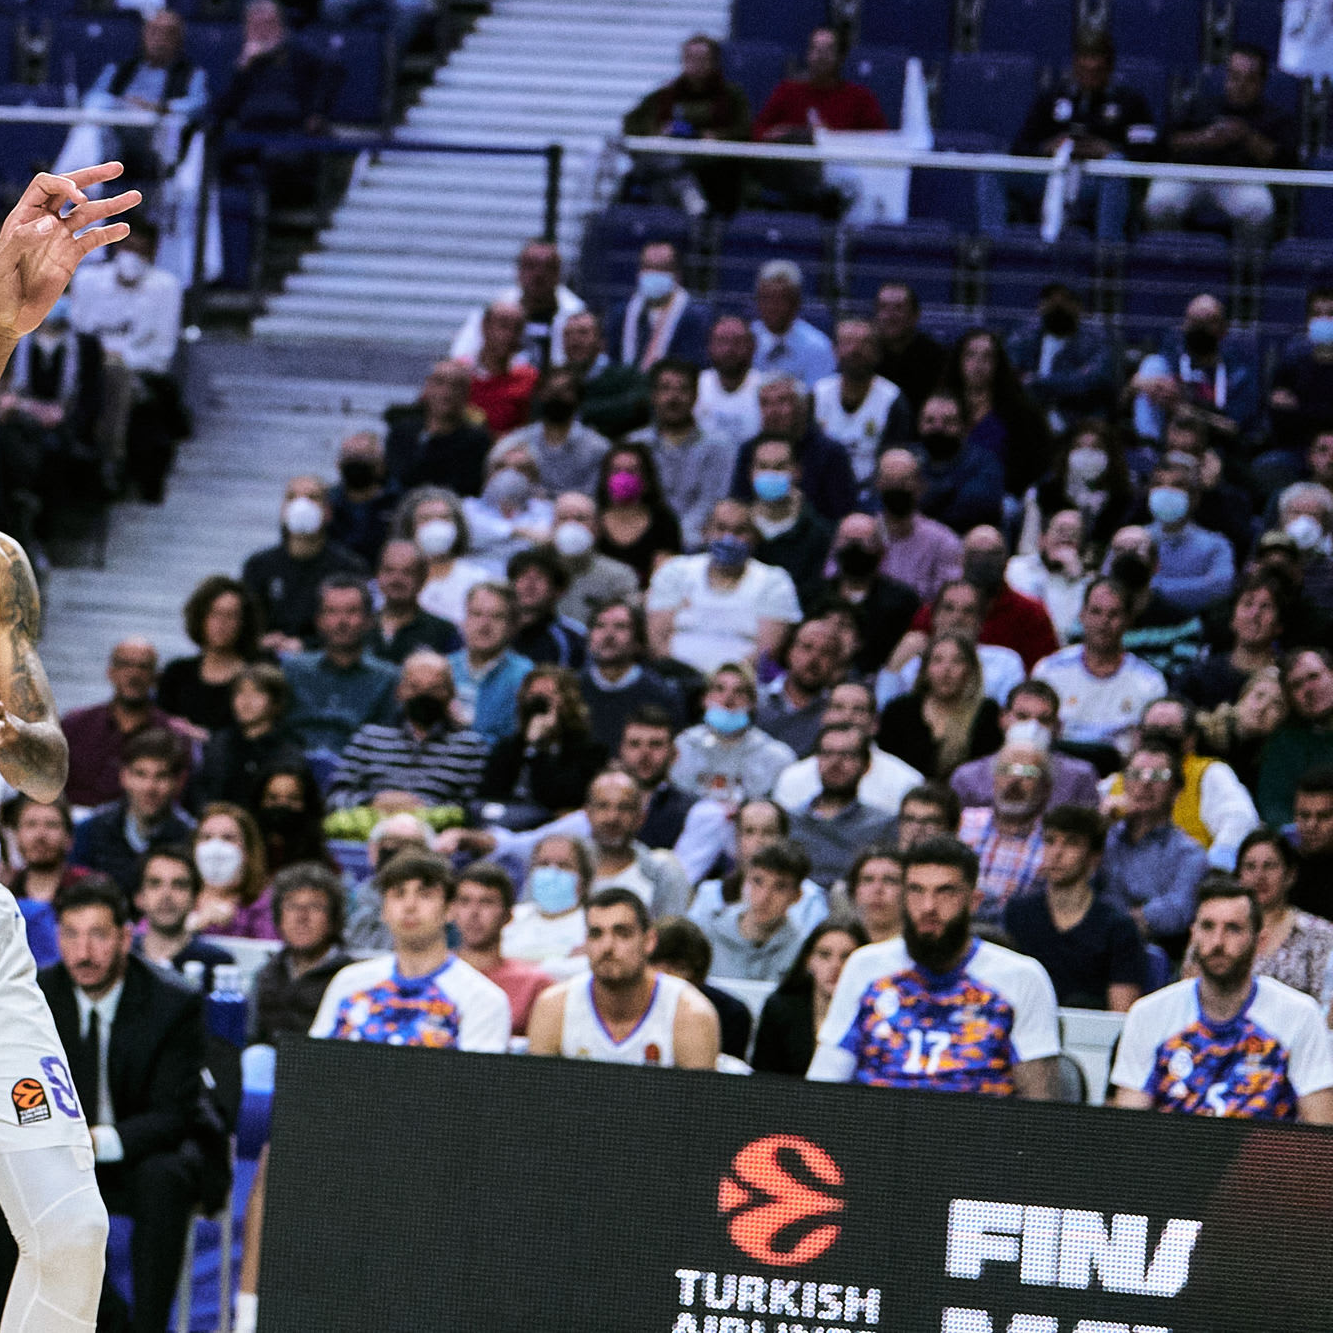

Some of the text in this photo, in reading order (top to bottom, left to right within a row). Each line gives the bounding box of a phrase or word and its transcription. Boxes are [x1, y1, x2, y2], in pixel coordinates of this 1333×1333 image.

[901, 1029, 951, 1074] 17
[39, 1056, 81, 1118] 8
[675, 1268, 882, 1324] TURKISH
